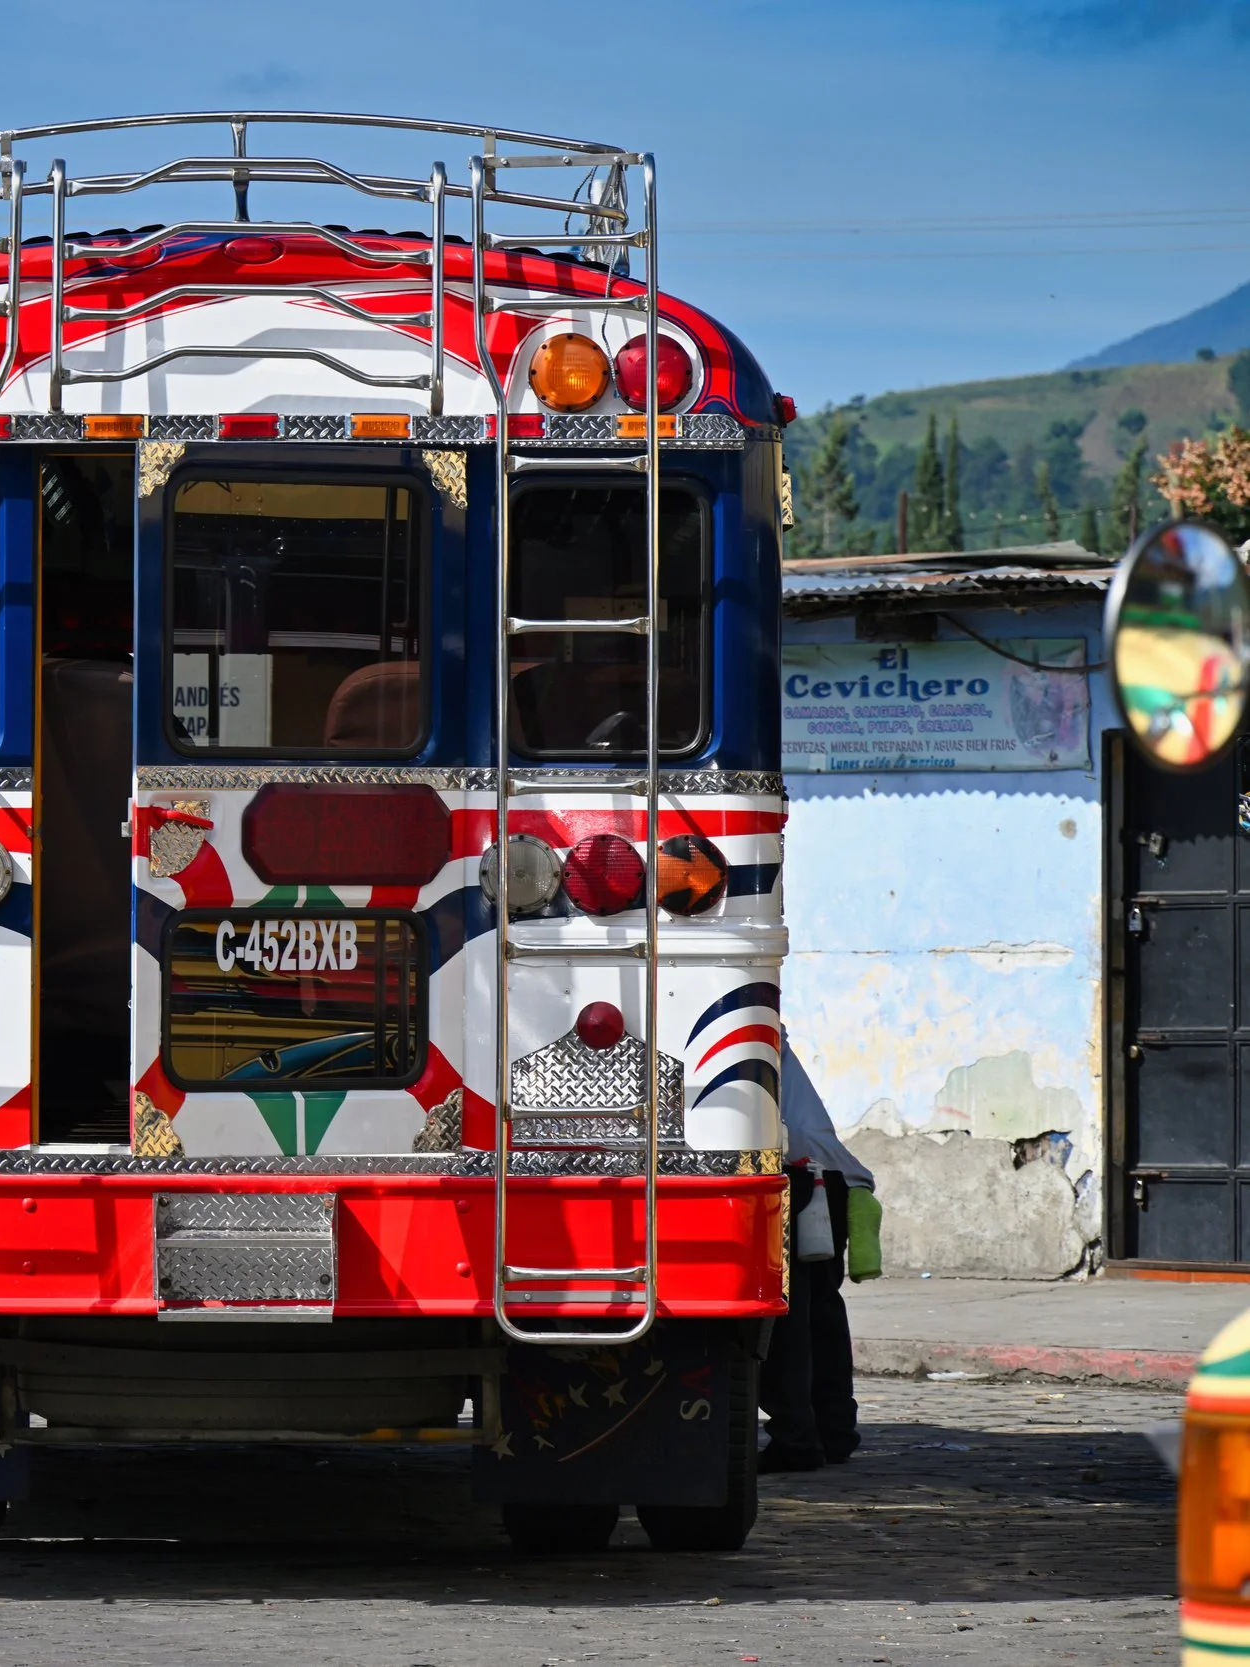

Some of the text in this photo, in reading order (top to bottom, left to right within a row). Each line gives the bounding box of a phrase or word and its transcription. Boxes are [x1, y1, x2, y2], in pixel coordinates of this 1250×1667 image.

[878, 648, 909, 671] El
[174, 683, 240, 707] ANDÉS
[785, 672, 990, 702] Cevichero
[929, 703, 993, 718] CARACOL,
[868, 720, 914, 735] PULPO,
[831, 741, 870, 753] MINERAL
[925, 740, 932, 752] Y
[933, 740, 964, 752] AGUAS
[966, 739, 988, 752] BIEN
[216, 919, 358, 972] C-452BXB
